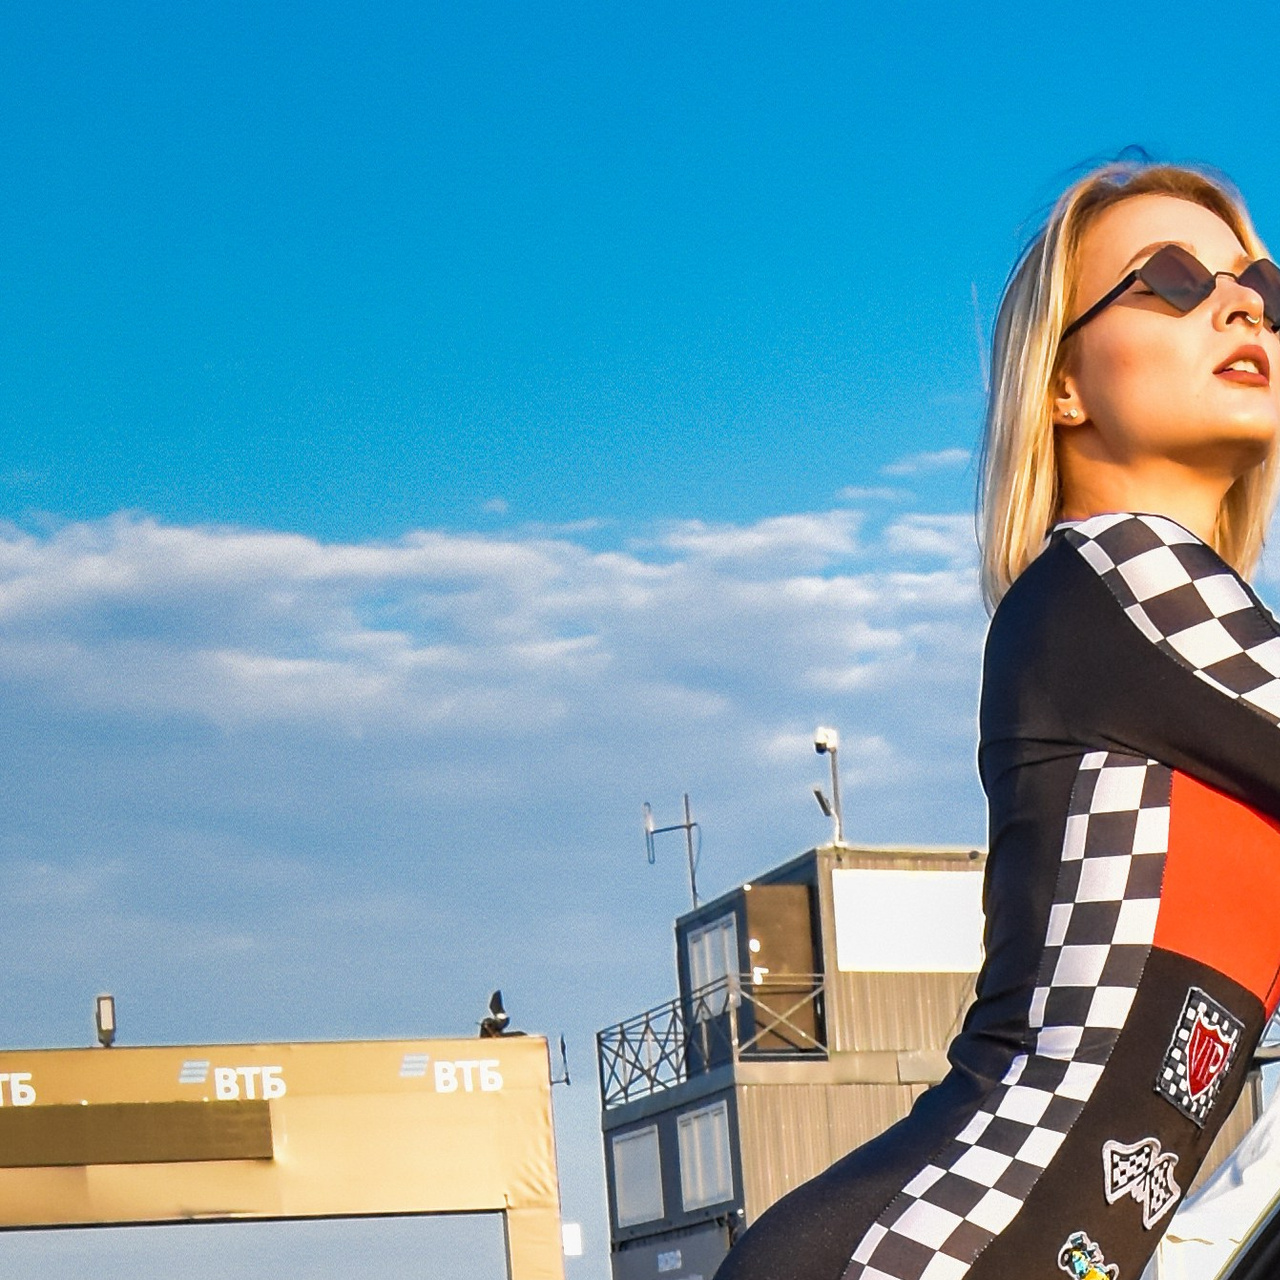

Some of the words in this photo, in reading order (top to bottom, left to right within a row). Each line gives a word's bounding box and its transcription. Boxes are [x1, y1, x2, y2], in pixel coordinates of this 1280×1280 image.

[1190, 1027, 1224, 1087] VIP
[214, 1066, 287, 1100] ВТБ
[434, 1059, 504, 1093] ВТБ
